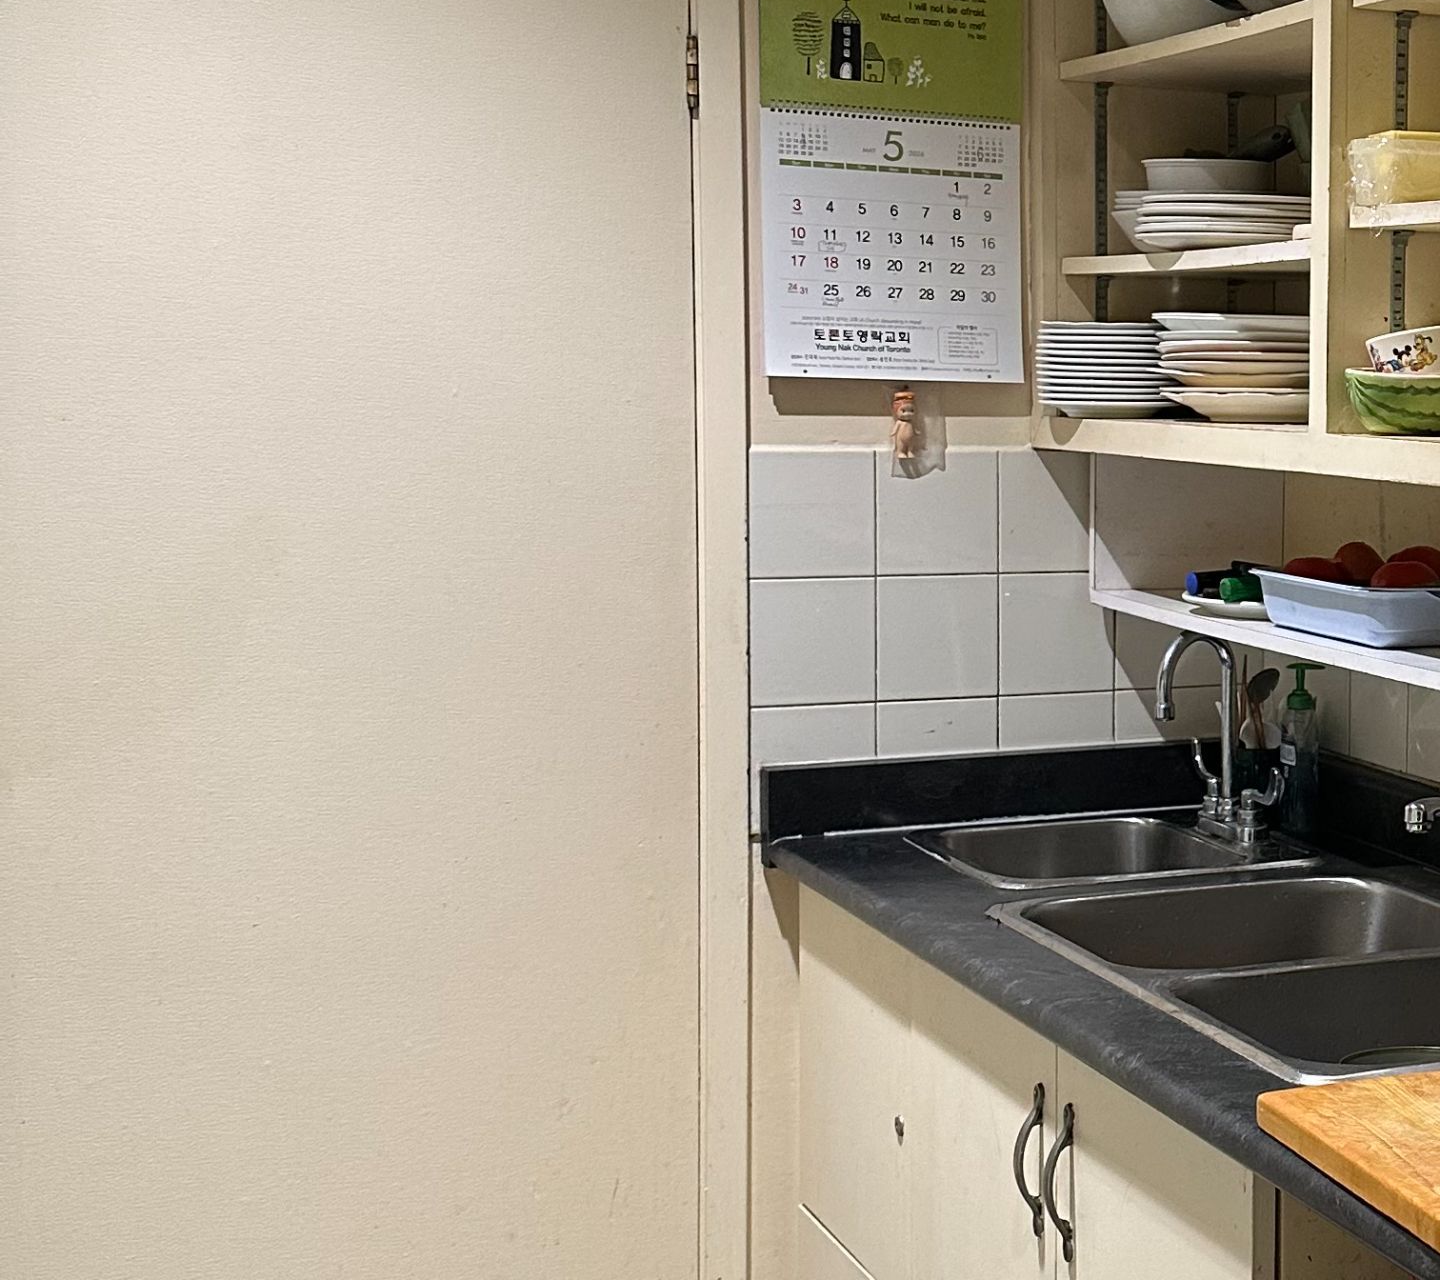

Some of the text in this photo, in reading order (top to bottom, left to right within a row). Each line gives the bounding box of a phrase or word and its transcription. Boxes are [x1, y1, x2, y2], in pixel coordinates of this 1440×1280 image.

[914, 3, 927, 11] will
[930, 5, 944, 13] not
[947, 6, 958, 14] be
[880, 13, 986, 30] What can man do to me?
[883, 130, 904, 161] 5
[953, 181, 992, 195] 1 2
[793, 199, 992, 222] 3 4 5 6 7 8 9
[791, 227, 996, 249] 10 11 12 13 14 15 16
[791, 255, 996, 276] 17 18 19 20 21 22 23
[788, 283, 996, 303] 24 31 25 26 27 28 29 30
[815, 343, 837, 352] Young
[838, 344, 851, 352] Nak
[853, 344, 877, 352] Church
[885, 345, 911, 353] Toronto
